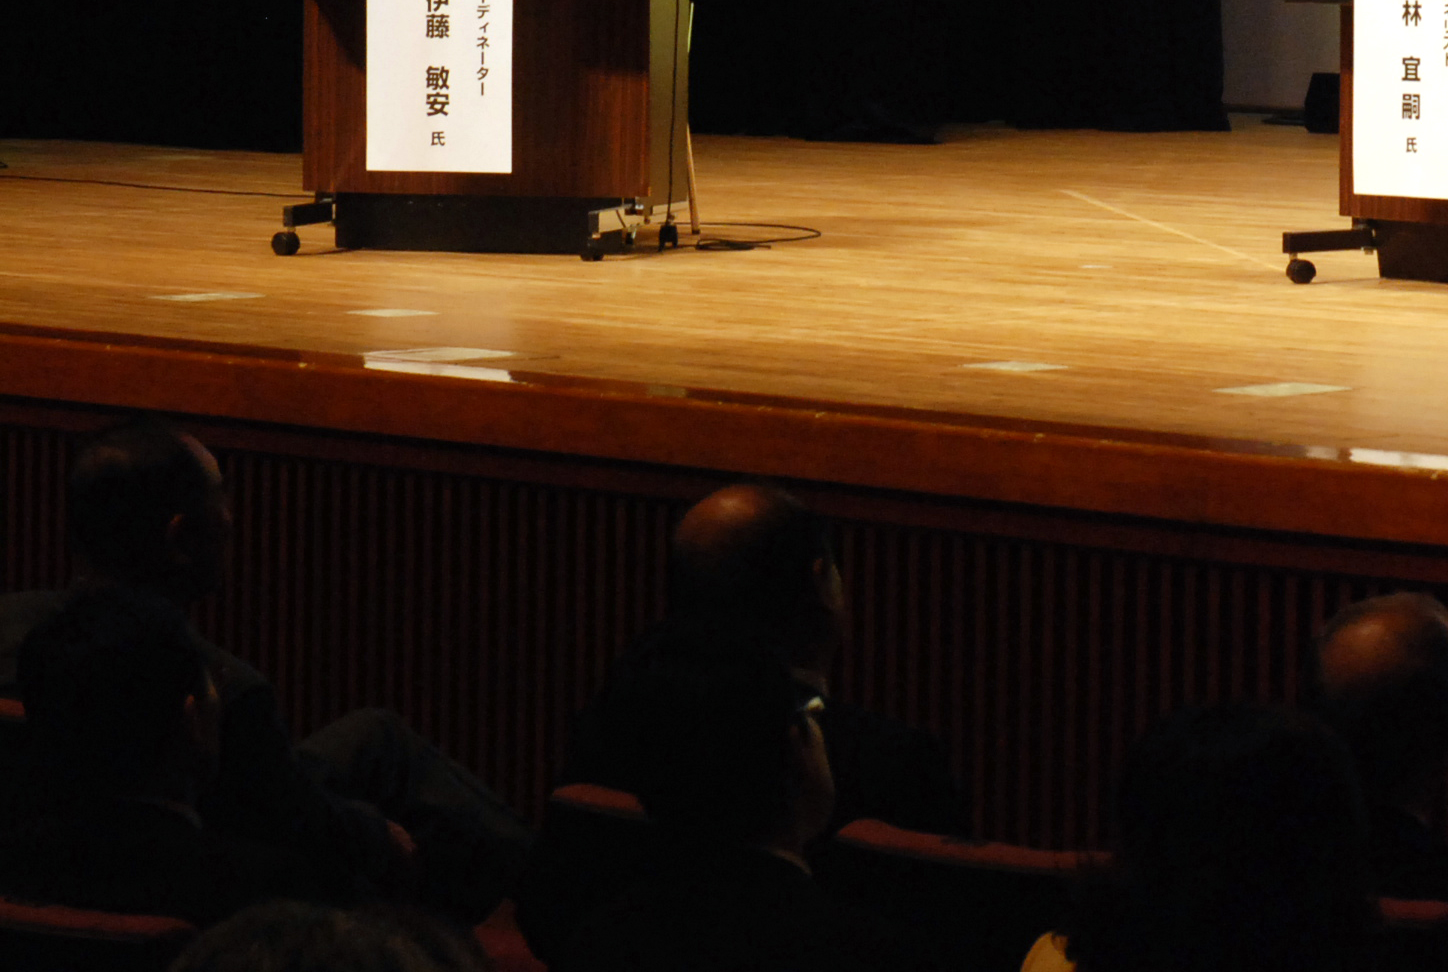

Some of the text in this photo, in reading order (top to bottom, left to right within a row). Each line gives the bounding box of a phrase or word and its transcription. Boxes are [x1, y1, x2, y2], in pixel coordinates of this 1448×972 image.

[425, 65, 450, 117] 敏安
[1401, 0, 1422, 154] 林 宜嗣 氏
[430, 130, 446, 147] 氏
